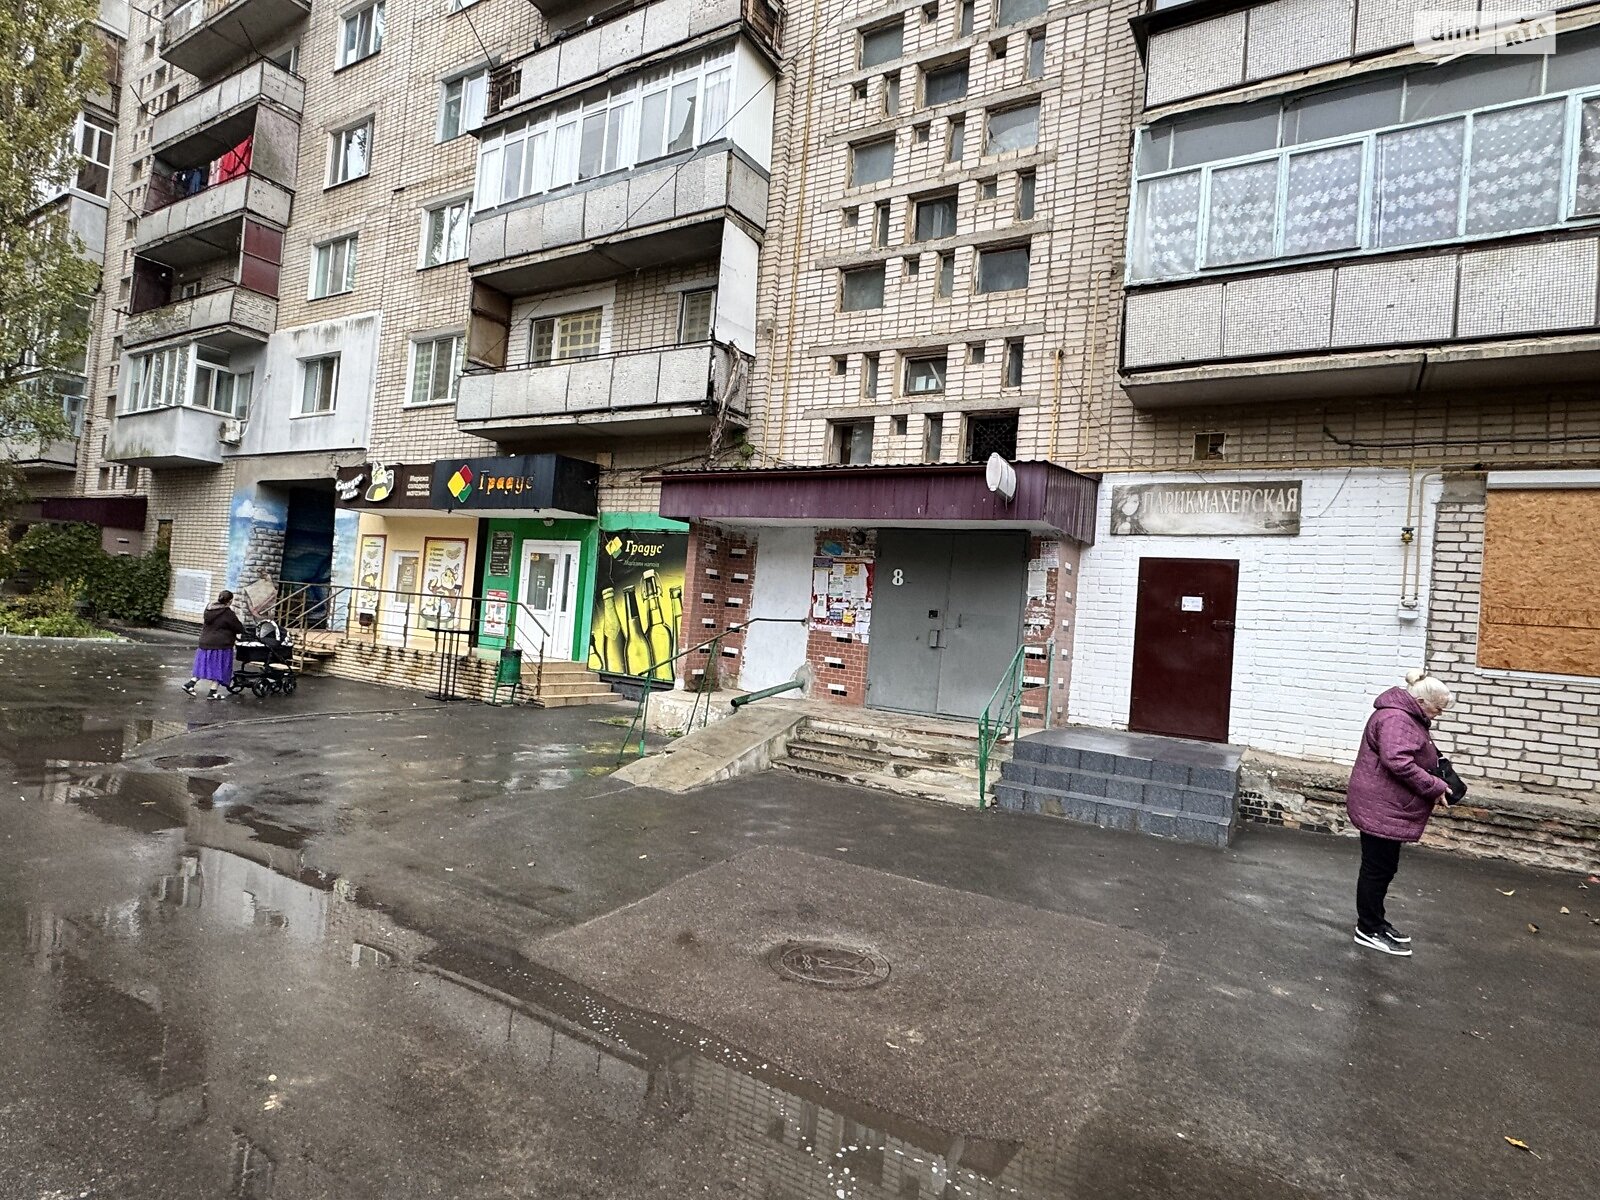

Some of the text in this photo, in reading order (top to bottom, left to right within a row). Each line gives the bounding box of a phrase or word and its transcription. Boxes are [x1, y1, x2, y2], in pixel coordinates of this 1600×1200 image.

[1142, 487, 1299, 514] ПАРИКМАХЕРСКАЯ
[625, 540, 663, 556] Градус
[892, 568, 904, 586] 8
